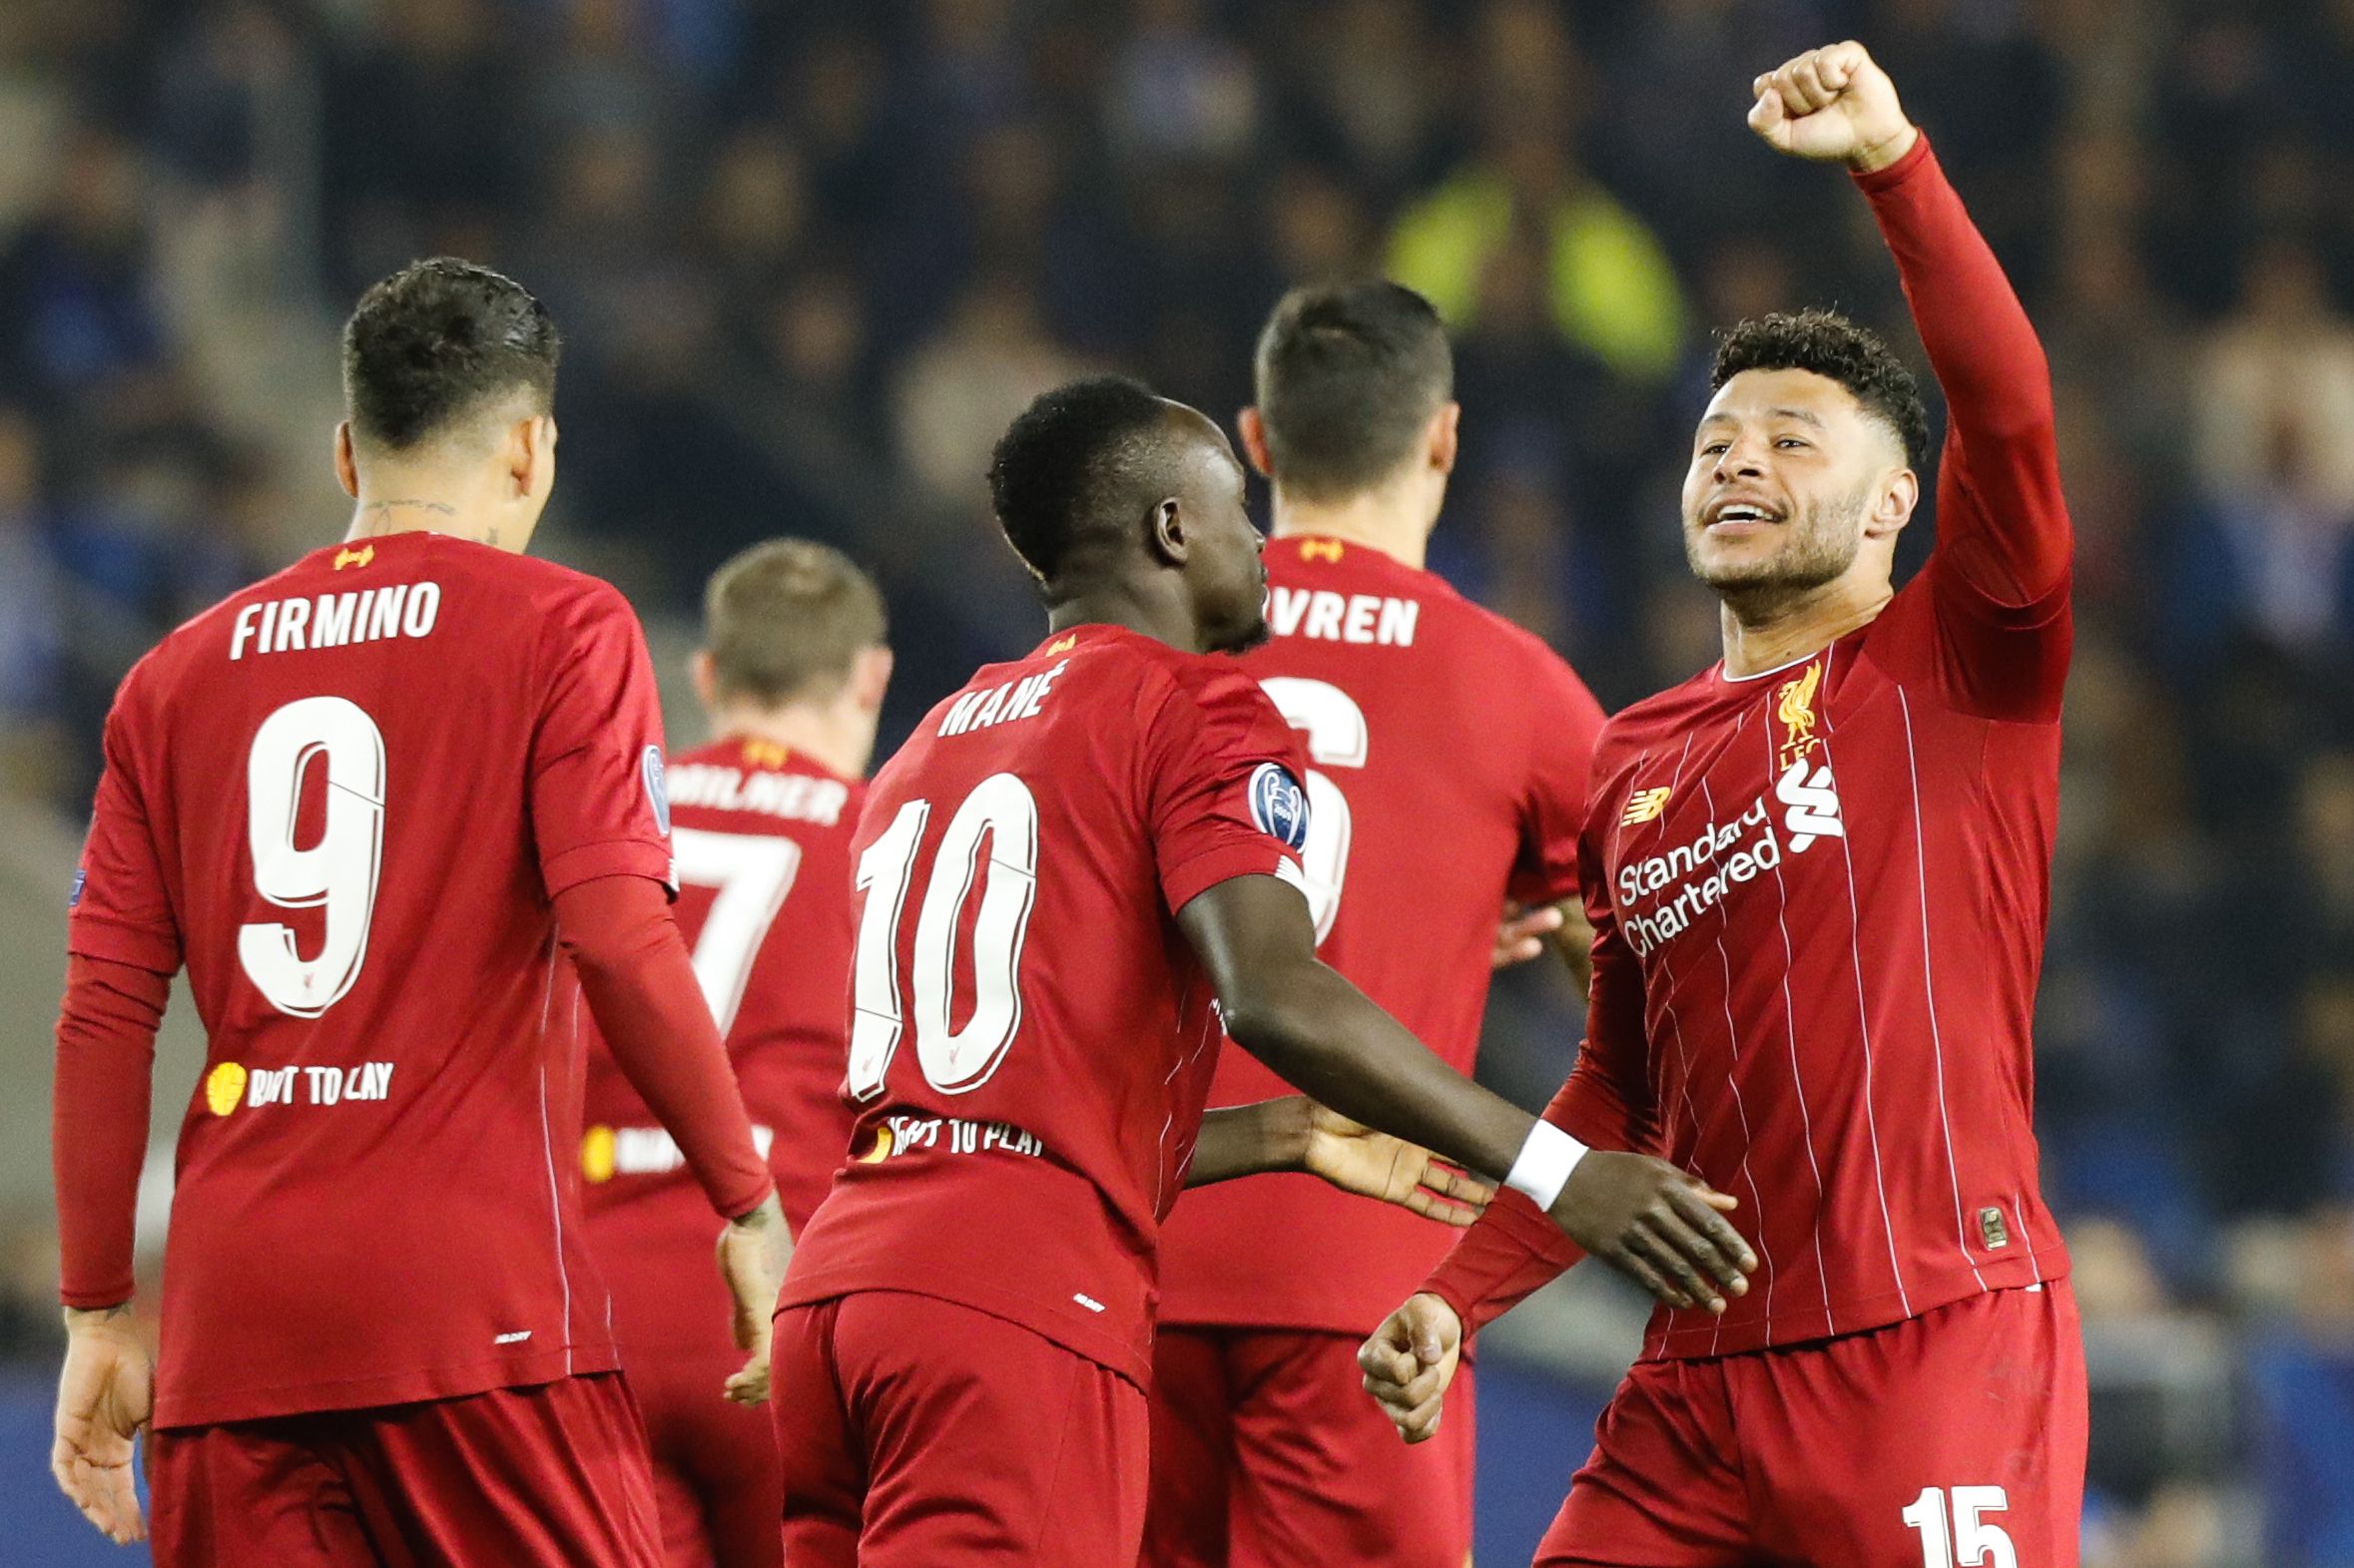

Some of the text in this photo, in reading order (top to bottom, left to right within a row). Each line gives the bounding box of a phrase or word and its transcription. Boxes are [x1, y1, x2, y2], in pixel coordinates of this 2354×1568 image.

[230, 582, 440, 660] FIRMINO
[1261, 585, 1419, 648] VREN
[937, 658, 1070, 738] MANÉ
[665, 764, 850, 826] MILNER
[238, 696, 386, 1018] 9
[1623, 825, 1781, 958] Chartered
[670, 825, 802, 1042] 7
[849, 772, 1038, 1102] 10
[303, 1066, 343, 1106] TO
[343, 1061, 394, 1100] LAY
[1902, 1485, 2021, 1568] 15
